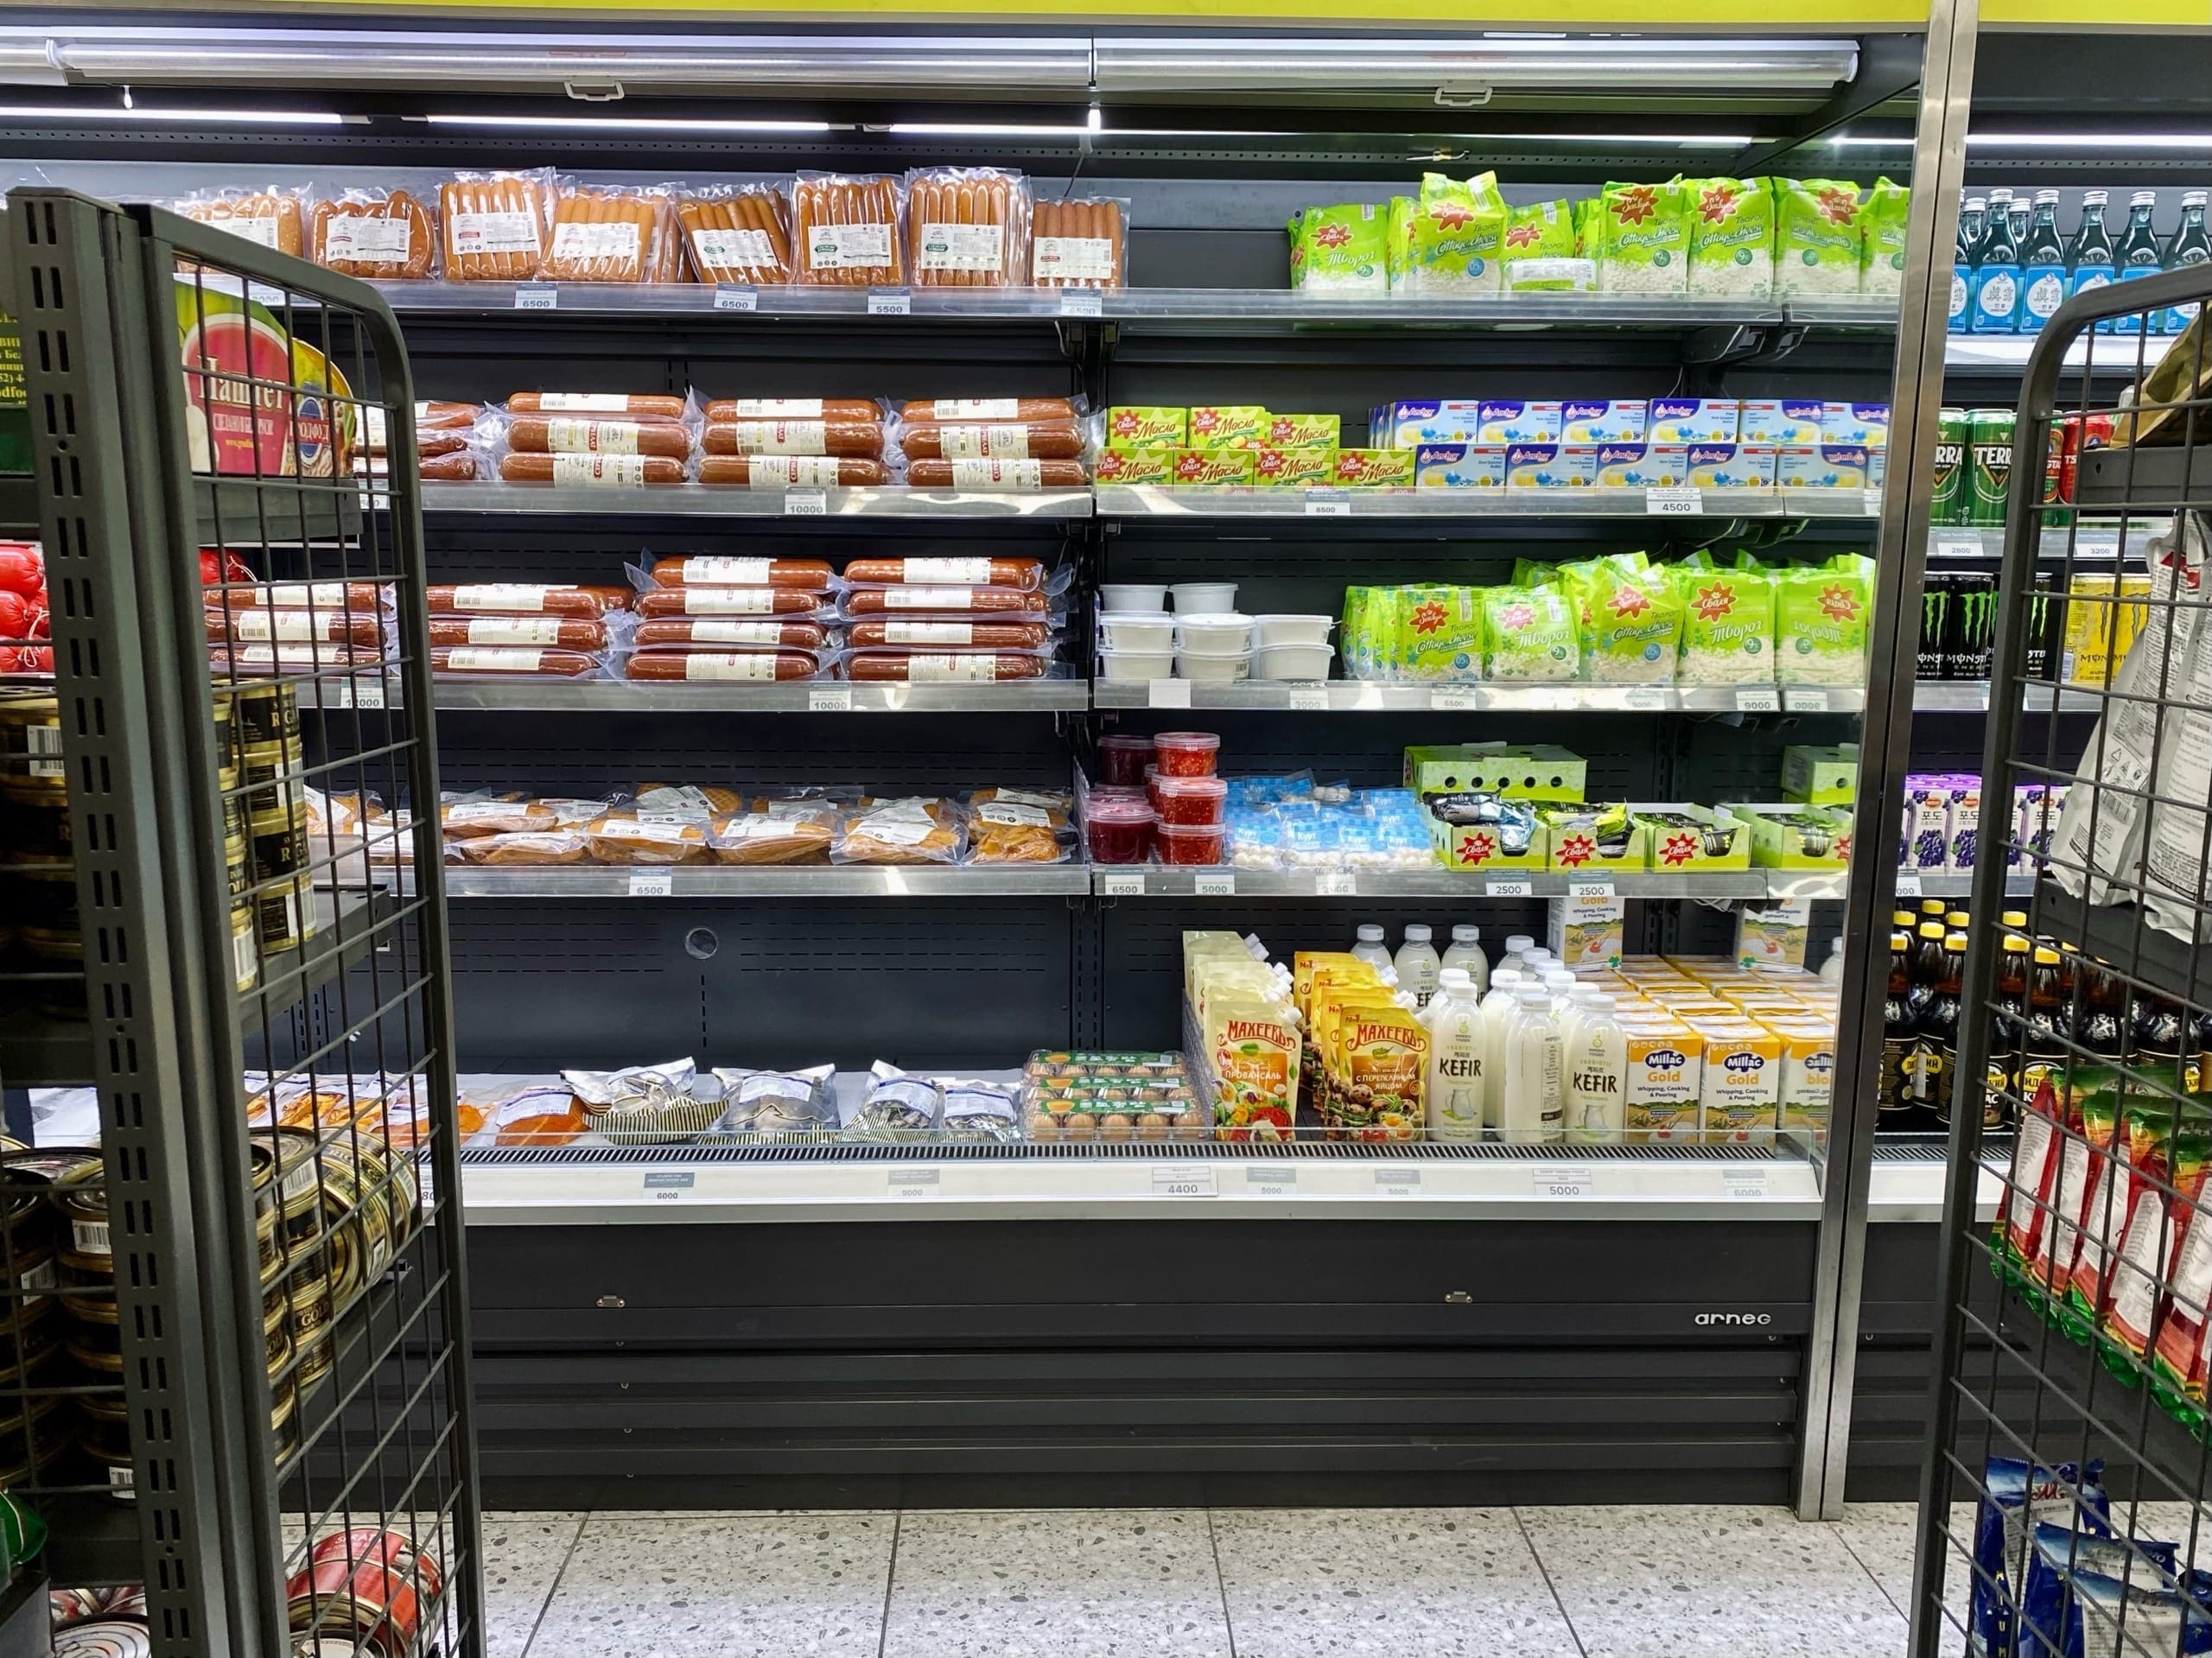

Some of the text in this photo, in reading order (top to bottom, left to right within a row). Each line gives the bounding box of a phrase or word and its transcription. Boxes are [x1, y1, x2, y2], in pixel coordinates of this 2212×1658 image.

[721, 300, 749, 309] 6500
[876, 304, 903, 313] 5500
[289, 420, 329, 441] ОДФУД
[1134, 421, 1176, 439] Масло
[1216, 418, 1255, 435] Масло
[1290, 427, 1329, 445] Масло
[1935, 446, 1962, 465] RRA
[1974, 446, 2012, 466] TERR
[1117, 462, 1161, 480] Масло
[1198, 464, 1243, 482] Масло
[1279, 459, 1323, 478] Масло
[1358, 464, 1404, 482] Масло
[1662, 503, 1691, 511] 4500
[1709, 620, 1762, 645] Творог
[814, 702, 848, 710] 10000
[1922, 810, 1943, 820] 포도
[1465, 843, 1491, 854] Сваля
[1565, 846, 1590, 857] Сваля
[1668, 844, 1693, 855] Сваля
[1496, 886, 1522, 894] 2500
[1579, 886, 1605, 895] 2500
[1649, 1054, 1683, 1064] Millac
[1727, 1057, 1762, 1067] Millac
[1439, 1058, 1482, 1077] KEFIR
[1573, 1071, 1618, 1093] KEFIR
[1647, 1071, 1681, 1083] Gold
[1726, 1074, 1759, 1085] Gold
[1637, 1085, 1665, 1094] Whipping,
[1168, 1185, 1198, 1194] 4400
[1549, 1186, 1580, 1196] 5000
[657, 1191, 678, 1200] 6000
